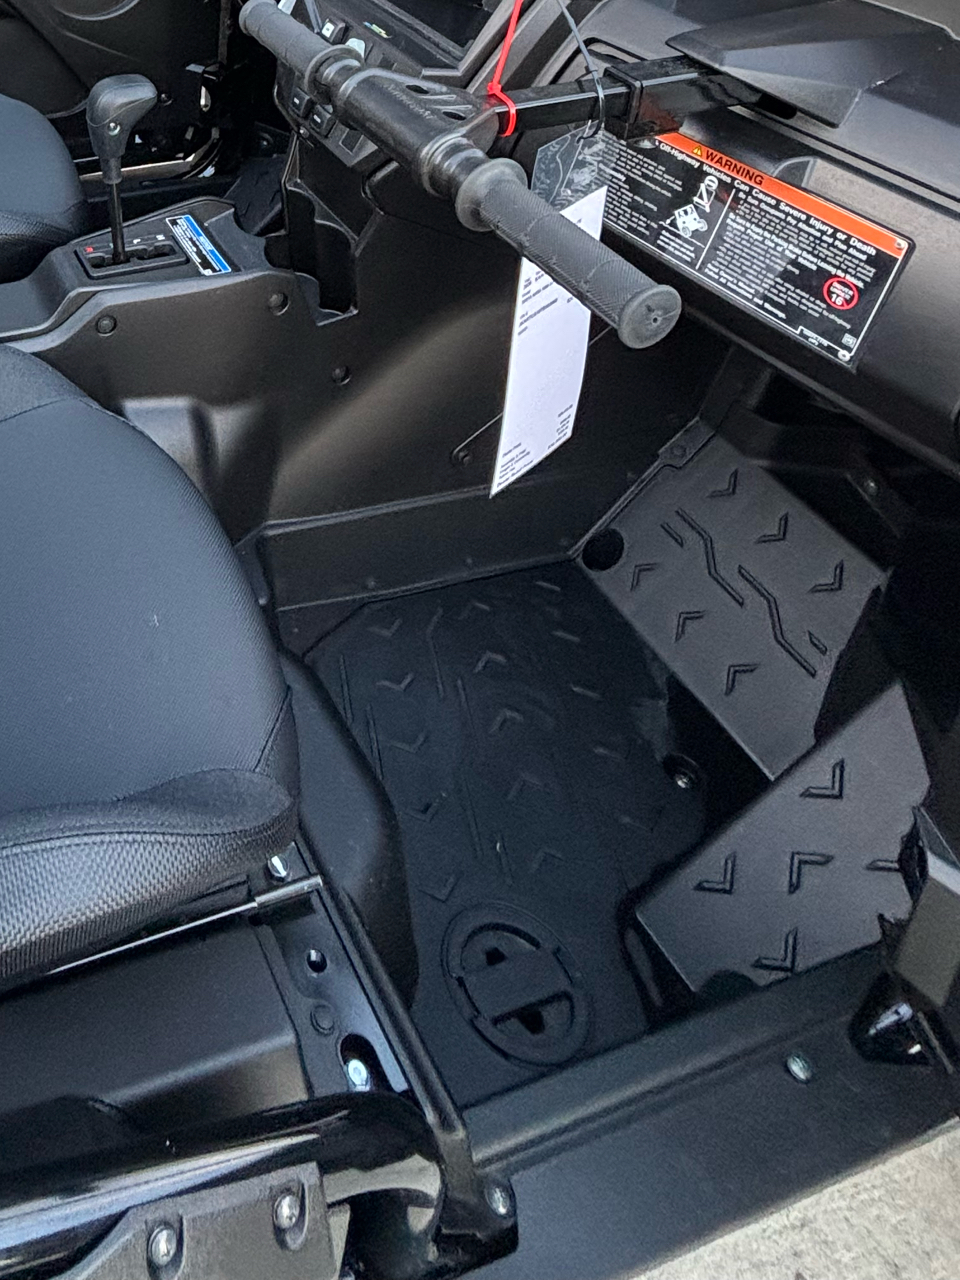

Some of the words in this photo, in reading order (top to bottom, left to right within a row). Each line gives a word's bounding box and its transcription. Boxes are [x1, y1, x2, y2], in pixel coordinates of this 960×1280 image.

[705, 149, 764, 185] WARNING
[659, 142, 700, 168] Off-Highway
[702, 163, 731, 183] Vehicles
[733, 179, 749, 191] Can
[751, 188, 776, 205] Cause
[778, 201, 806, 220] Severe
[808, 217, 833, 234] Injury
[836, 232, 847, 240] or
[849, 237, 876, 255] Death
[746, 195, 758, 205] Sure
[786, 215, 797, 225] Pay
[821, 234, 833, 243] and
[831, 293, 844, 305] 16
